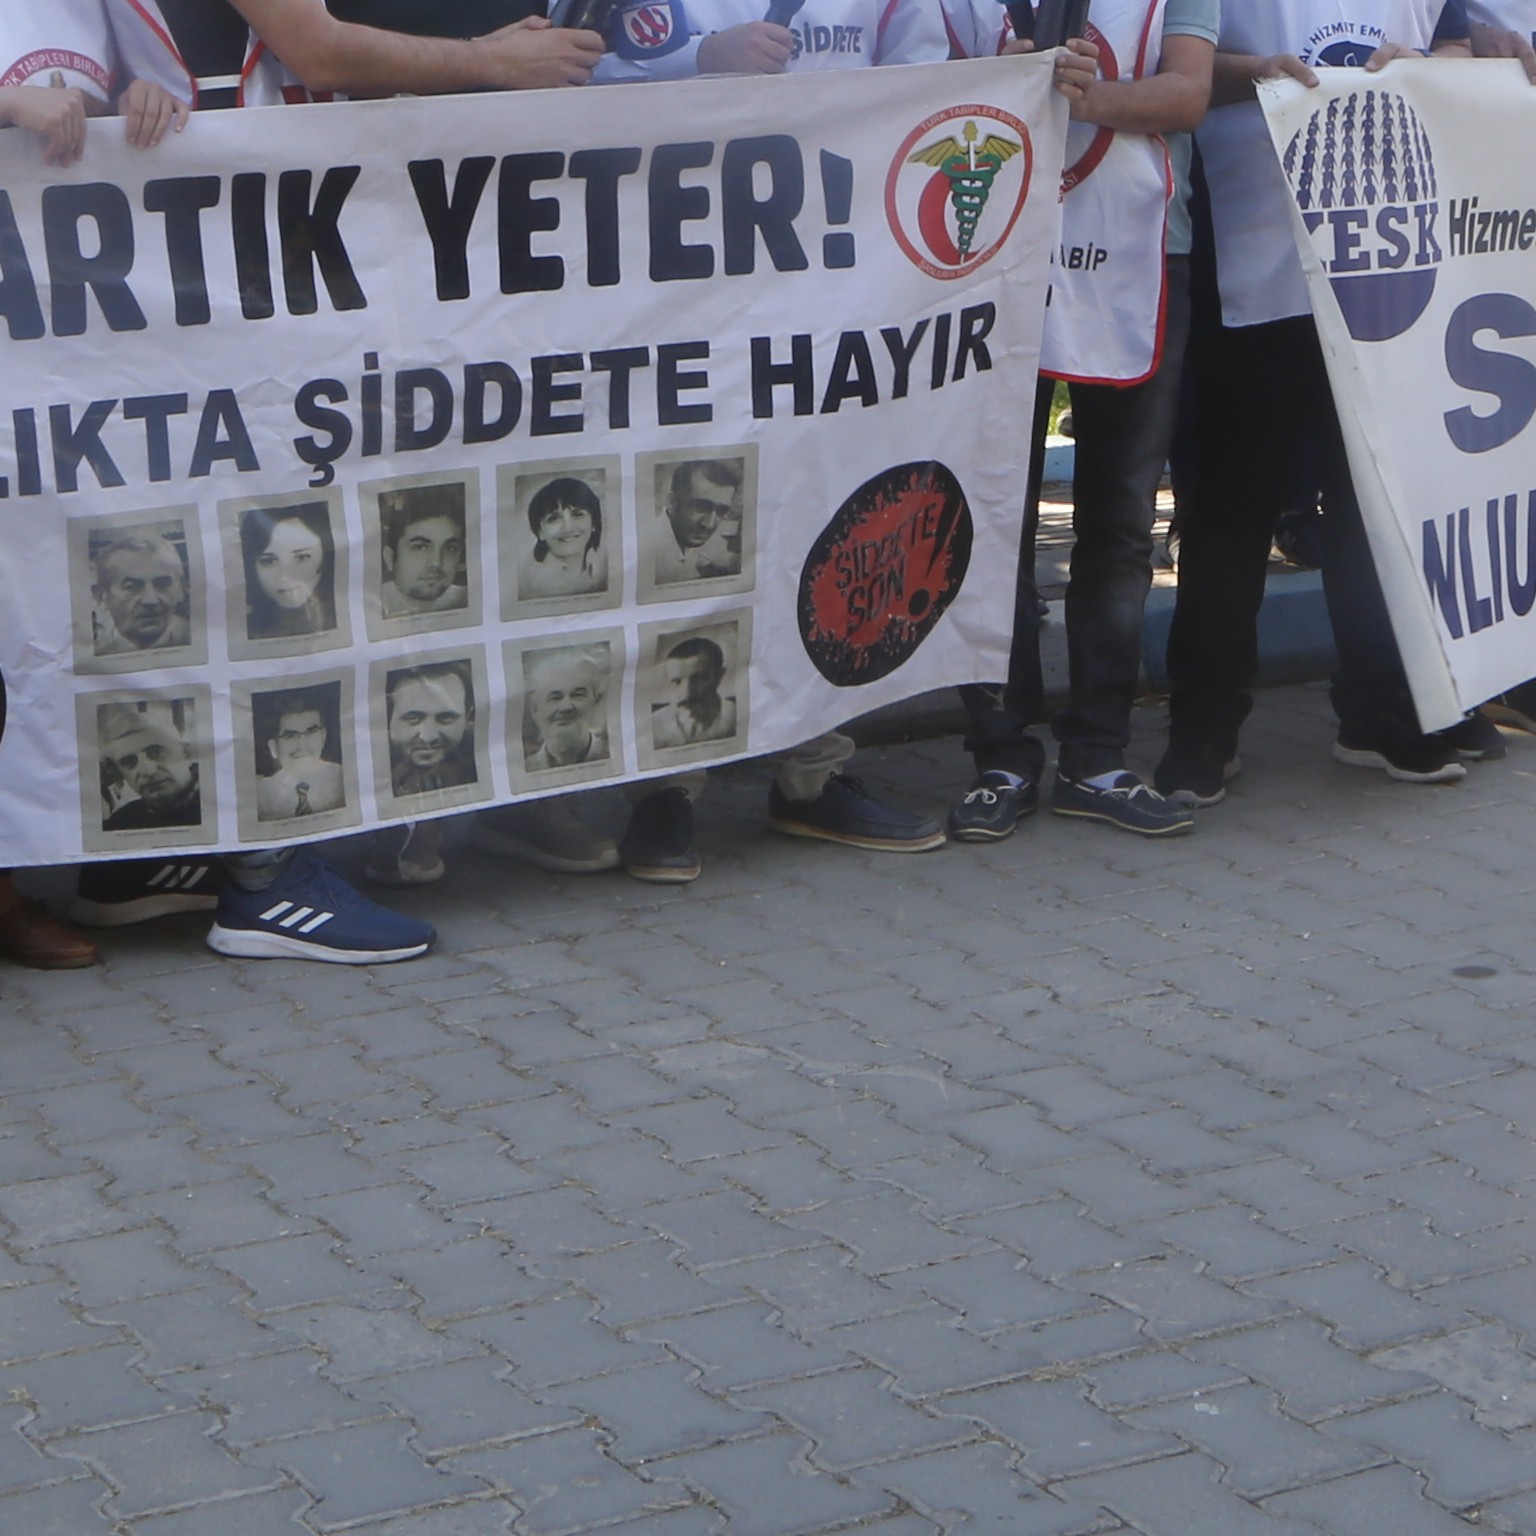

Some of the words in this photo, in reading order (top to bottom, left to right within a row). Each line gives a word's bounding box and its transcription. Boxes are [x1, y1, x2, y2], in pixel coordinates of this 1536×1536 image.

[407, 132, 856, 304] YETER!
[294, 337, 712, 489] ŞİDDETE
[751, 299, 997, 419] HAYIR
